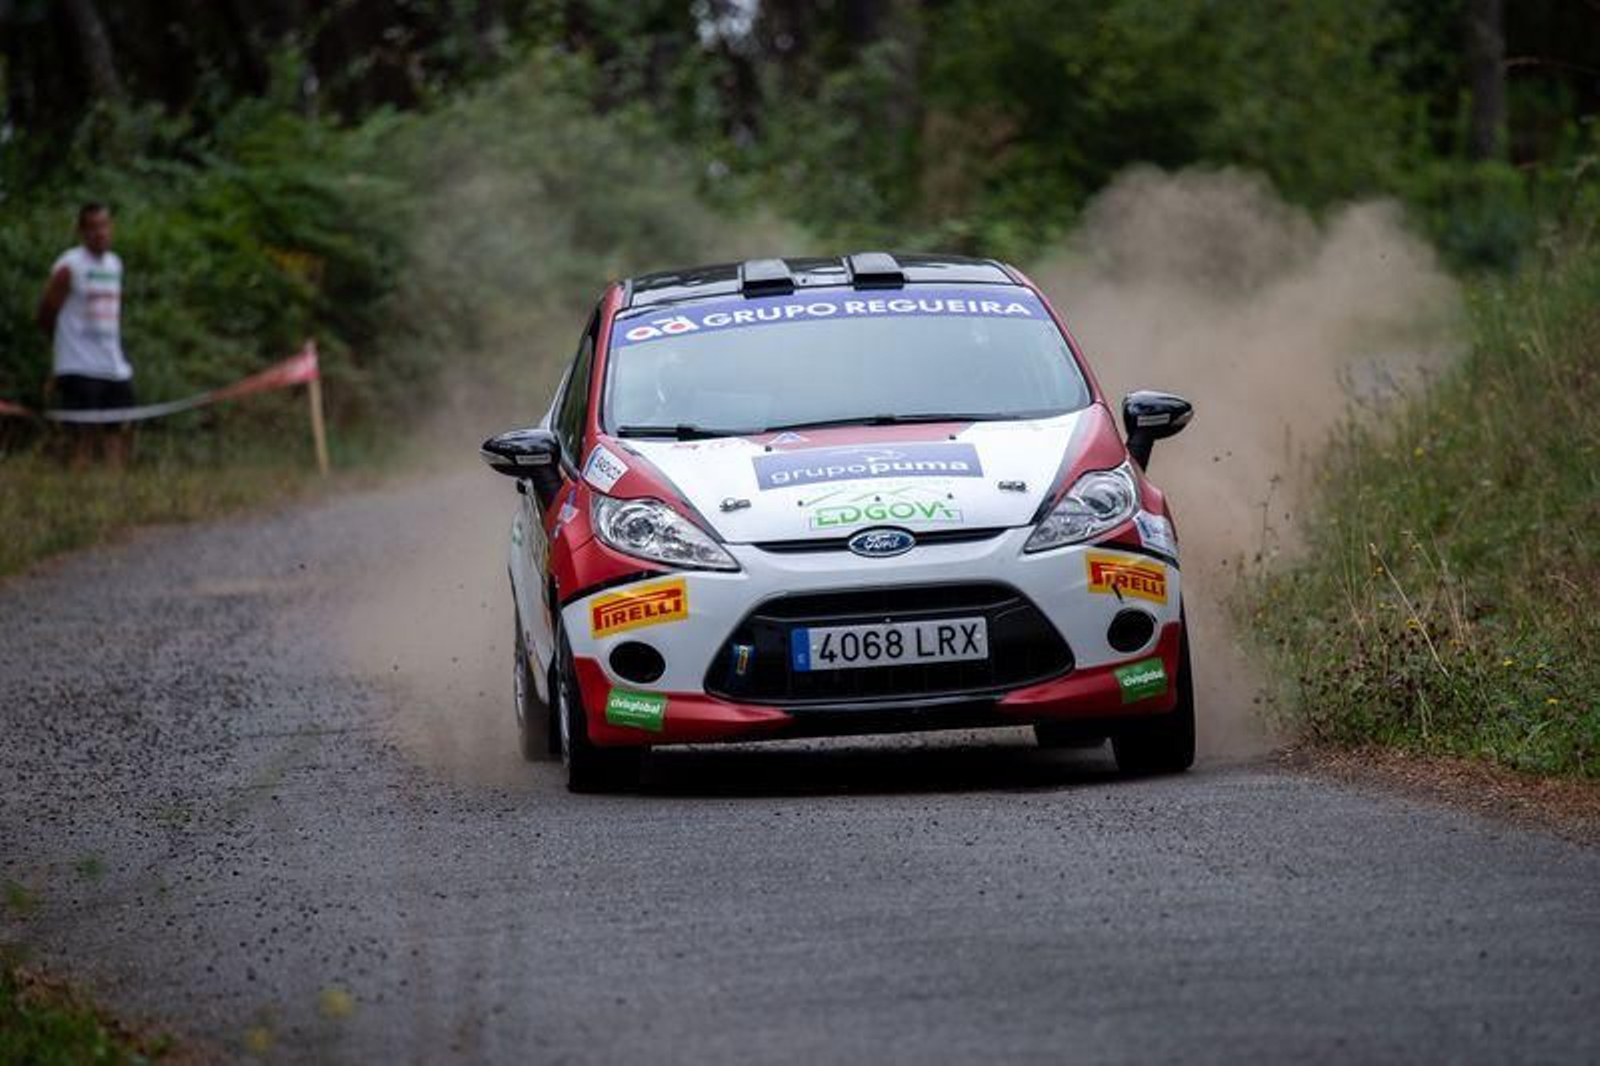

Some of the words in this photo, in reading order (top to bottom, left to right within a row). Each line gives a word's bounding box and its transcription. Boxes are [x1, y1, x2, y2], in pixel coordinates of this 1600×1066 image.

[703, 302, 836, 327] GRUPO
[846, 299, 1030, 315] REGUEIRA
[771, 461, 969, 484] grupopuma
[863, 534, 900, 550] Ford
[1090, 561, 1164, 596] PIRELLI
[593, 589, 682, 630] PIRELLI
[819, 630, 904, 663] 4068
[917, 624, 979, 657] LRX
